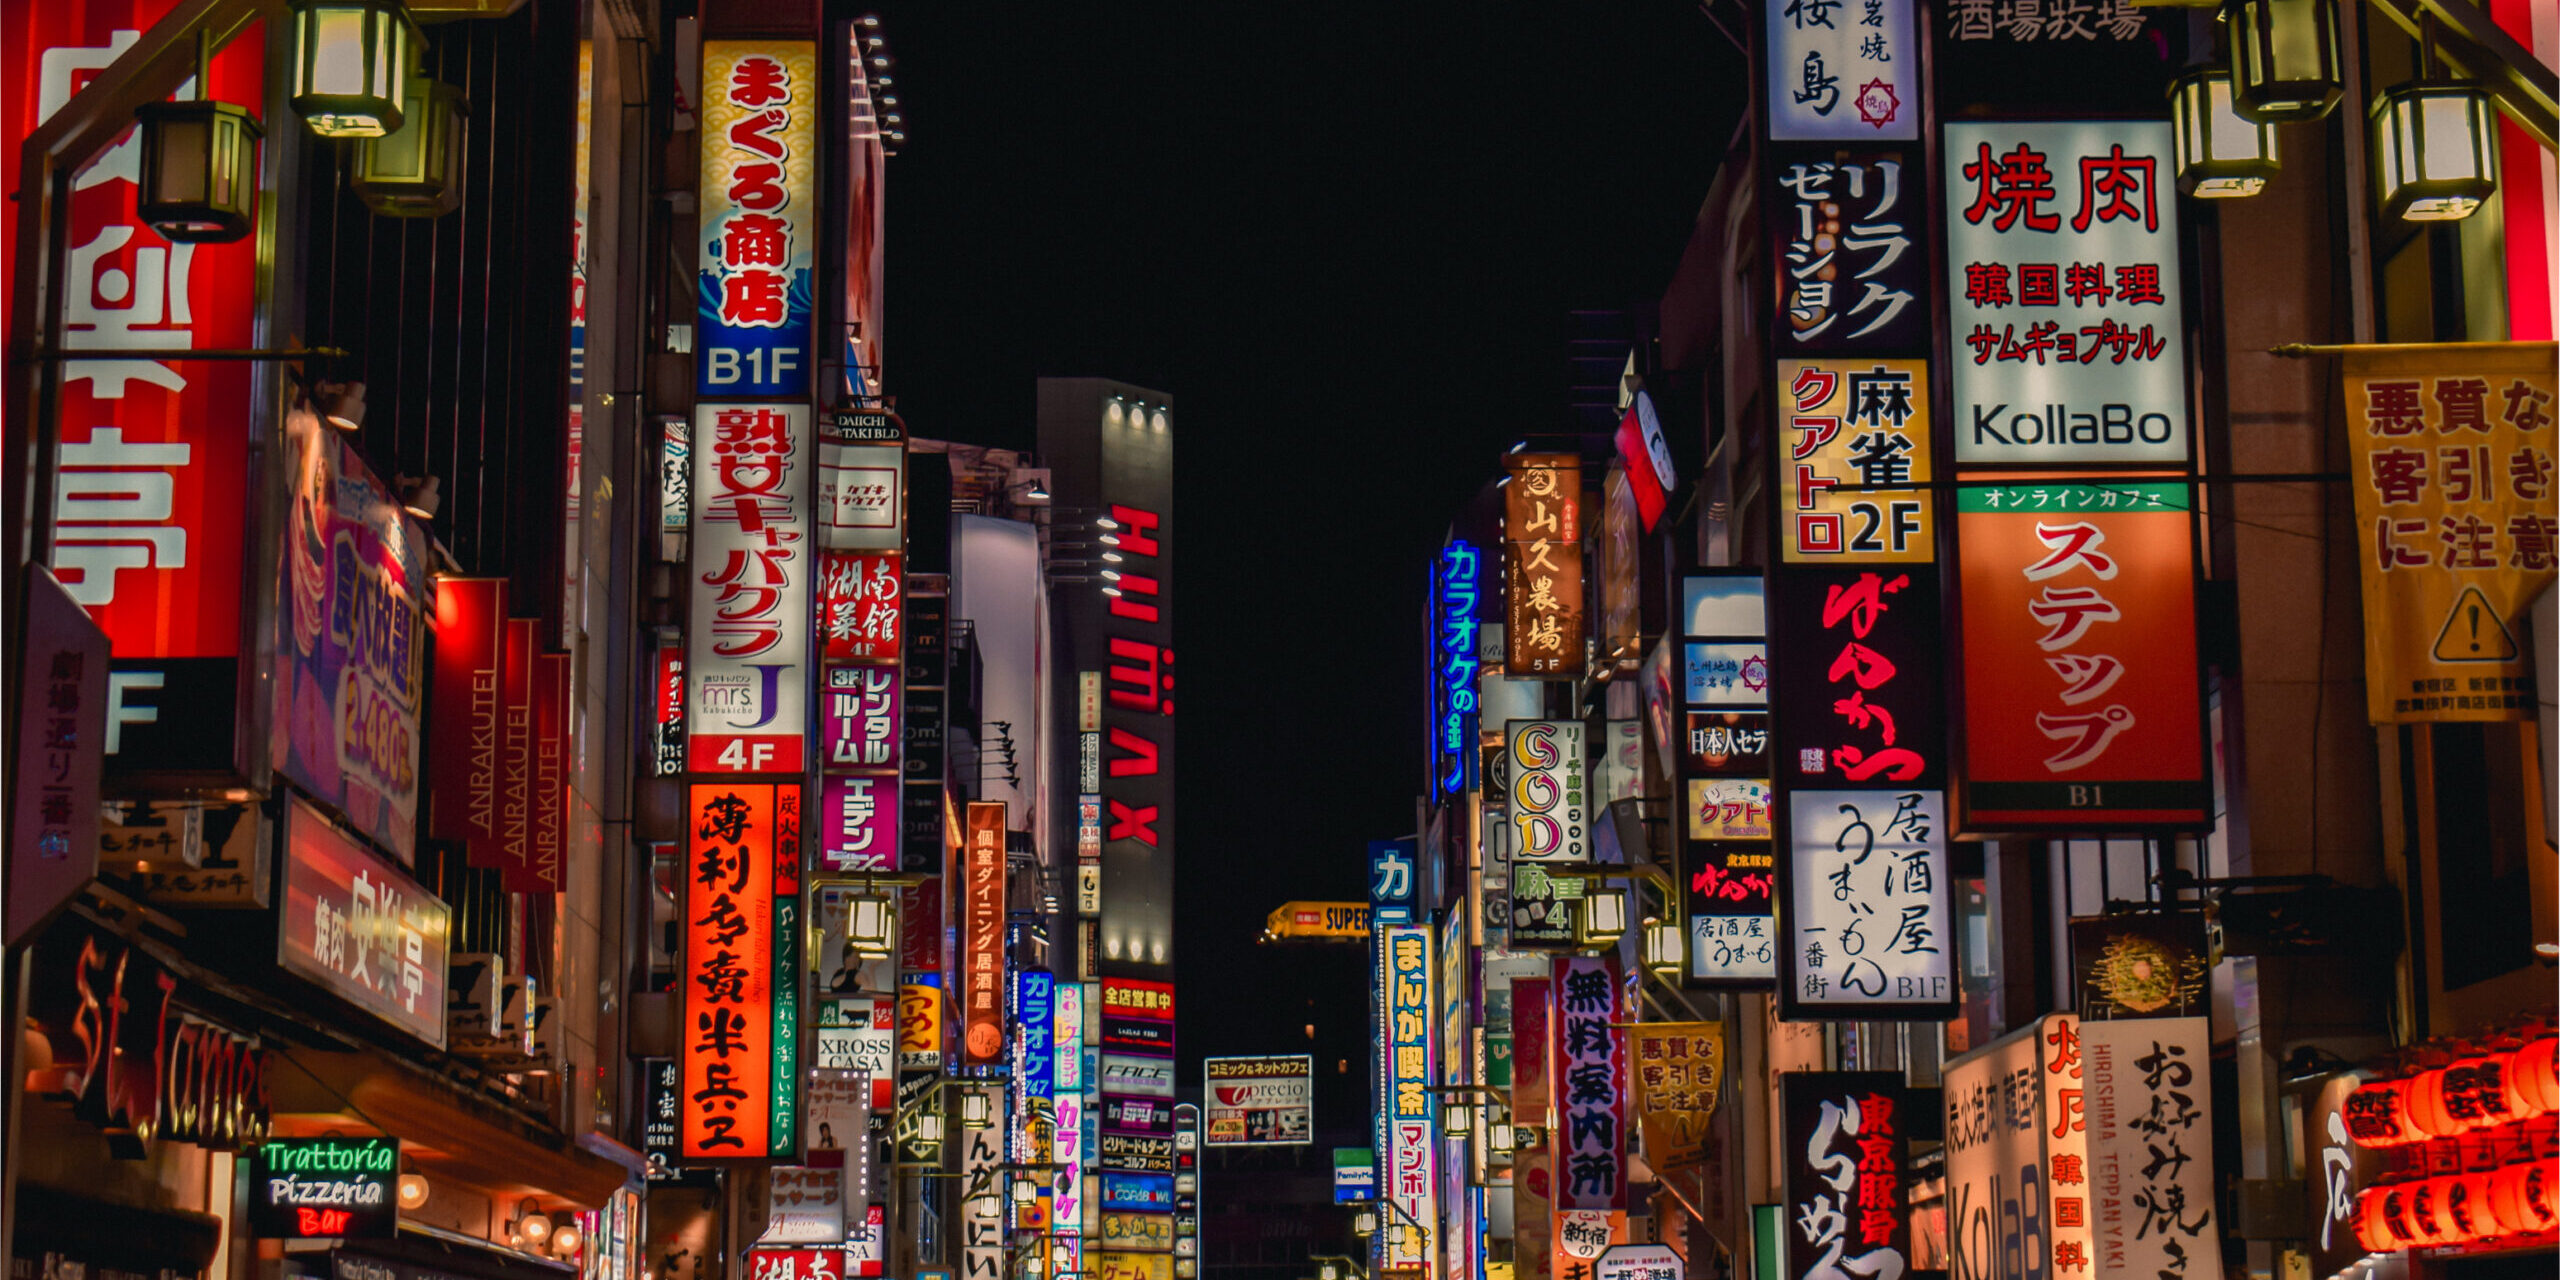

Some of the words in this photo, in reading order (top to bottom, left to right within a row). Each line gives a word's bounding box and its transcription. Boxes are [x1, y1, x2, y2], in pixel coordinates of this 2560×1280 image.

[719, 53, 793, 329] まぐろ商店
[1963, 141, 2160, 234] 焼肉
[1842, 160, 1914, 339] リラク
[1965, 262, 2165, 307] 韓国料理
[707, 348, 800, 385] B1F
[1966, 319, 2166, 365] サムギョプサル
[838, 416, 886, 427] DAIICHI
[874, 428, 900, 439] BLD
[1845, 366, 1915, 493] 麻雀
[1973, 403, 2173, 446] KollaBo
[2366, 379, 2551, 437] 悪質な
[1791, 367, 1844, 554] クアトロ
[2370, 446, 2552, 505] 客引き
[702, 408, 802, 659] 熟女キャバクラ
[1849, 501, 1923, 552] 2F
[1984, 489, 2163, 509] オンラインカフェ
[828, 554, 899, 601] 湖南
[1525, 501, 1564, 652] 山久農場
[2377, 514, 2560, 571] に注意
[2022, 520, 2136, 774] ステップ
[469, 669, 495, 832] ANRAKUTEI
[832, 692, 860, 765] ルーム
[865, 669, 893, 765] レンタル
[1691, 729, 1768, 756] 日本人セラ
[504, 705, 529, 857] ANRAKUTEI
[718, 738, 775, 771] 4F
[1513, 723, 1563, 857] GOD
[536, 737, 560, 883] ANRAKUTEI
[843, 778, 875, 852] エデン
[1700, 802, 1774, 825] クアト
[2069, 784, 2104, 807] B1
[777, 795, 800, 882] 炭火串焼
[1883, 793, 1940, 956] 居酒屋
[976, 829, 994, 1009] 個室ダイニング居酒屋
[1376, 853, 1411, 921] カ
[1828, 805, 1888, 998] うまいもん
[314, 895, 346, 975] 焼肉
[352, 870, 424, 1014] 安楽亭
[1695, 917, 1765, 938] 居酒屋
[1802, 926, 1829, 1000] 一番街
[1105, 986, 1171, 1011] 全店営業中
[1897, 975, 1947, 998] B1F
[820, 1039, 890, 1055] XROSS
[1023, 974, 1051, 1076] カラオケ
[1396, 938, 1425, 1115] まんが喫茶
[829, 1056, 883, 1070] CASA
[1209, 1061, 1308, 1076] コミック&ネットカフェ
[1566, 968, 1615, 1200] 無料案内所
[2092, 1043, 2117, 1140] HIROSHIMA
[268, 1141, 392, 1172] Trattoria
[271, 1174, 382, 1205] Pizzeria
[1402, 1126, 1423, 1218] マンボー
[1856, 1092, 1899, 1246] 東京豚骨
[298, 1207, 352, 1236] Bar
[1563, 1221, 1608, 1246] 新宿
[2101, 1152, 2125, 1270] TEPPANYAKI
[1579, 1245, 1594, 1256] の
